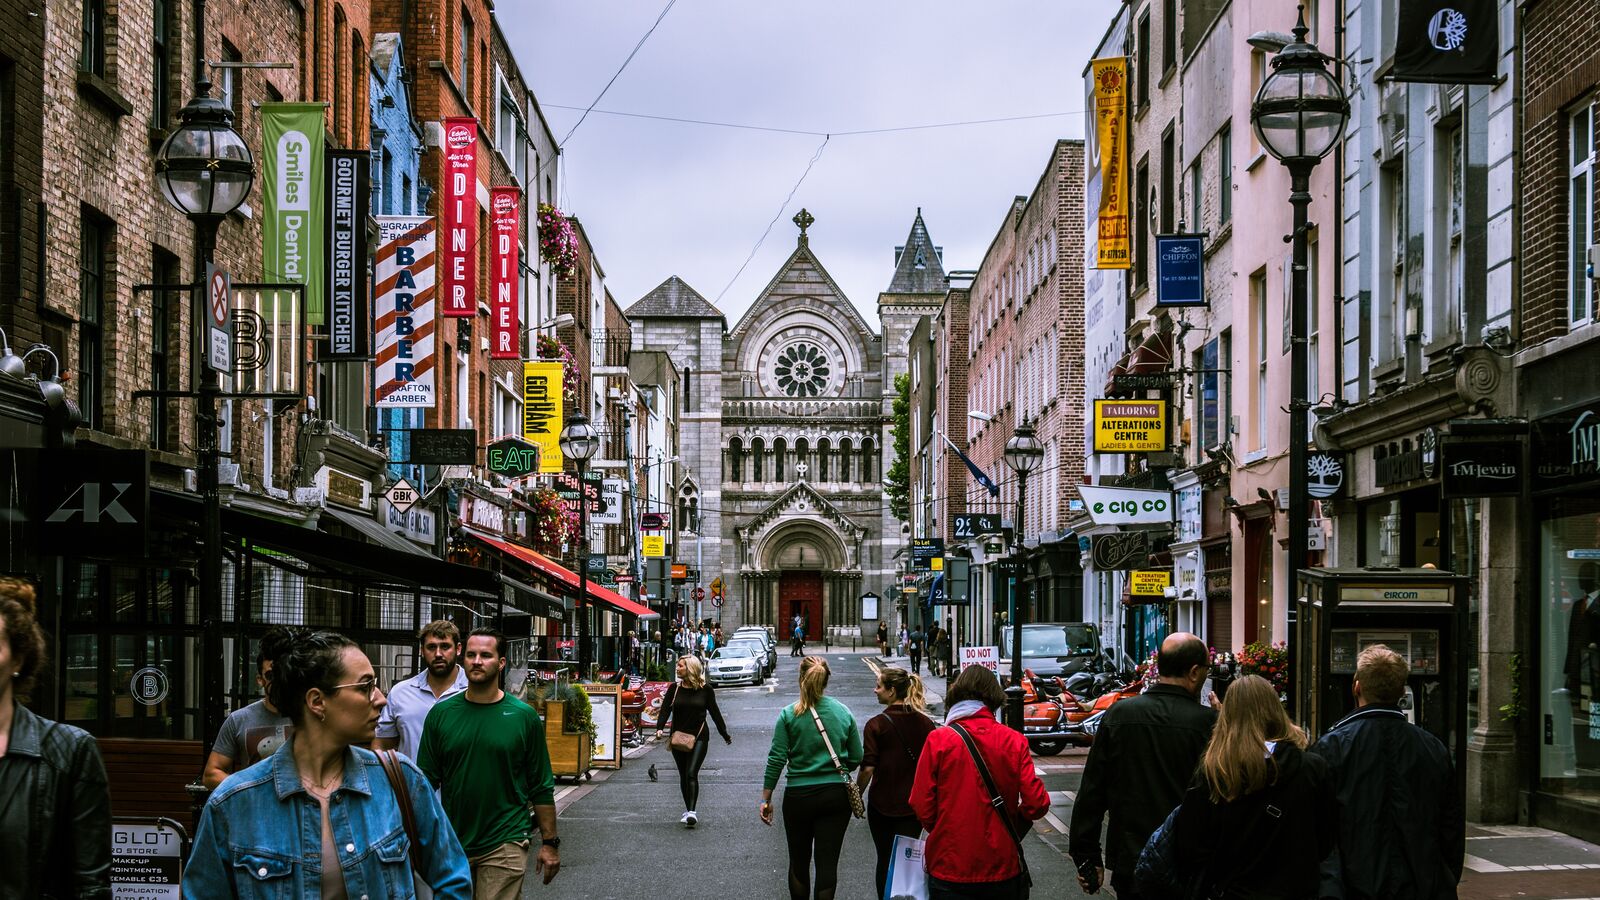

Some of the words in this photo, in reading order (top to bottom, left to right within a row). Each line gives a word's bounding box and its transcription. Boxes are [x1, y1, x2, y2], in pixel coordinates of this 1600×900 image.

[286, 141, 303, 204] Smiles
[335, 158, 353, 227] GOURMET
[388, 222, 432, 230] GRAFTON
[1100, 218, 1127, 237] CENTRE
[285, 215, 303, 281] Dental
[452, 173, 467, 309] DINER
[335, 231, 352, 287] BURGER
[1162, 253, 1198, 261] CHIFFON
[498, 234, 511, 352] DINER
[335, 290, 351, 354] KITCHEN
[395, 246, 417, 382] BARBER
[387, 384, 431, 392] GRAFTON
[525, 375, 558, 434] GOTHAM
[1105, 406, 1157, 416] TAILORING
[1101, 420, 1162, 430] ALTERATIONS
[1114, 431, 1149, 441] CENTRE
[490, 447, 534, 471] EAT
[393, 491, 412, 501] GBK
[1093, 502, 1105, 514] e
[1142, 499, 1167, 512] co
[966, 649, 976, 658] DO
[977, 648, 991, 658] NOT
[115, 832, 172, 844] GLOT
